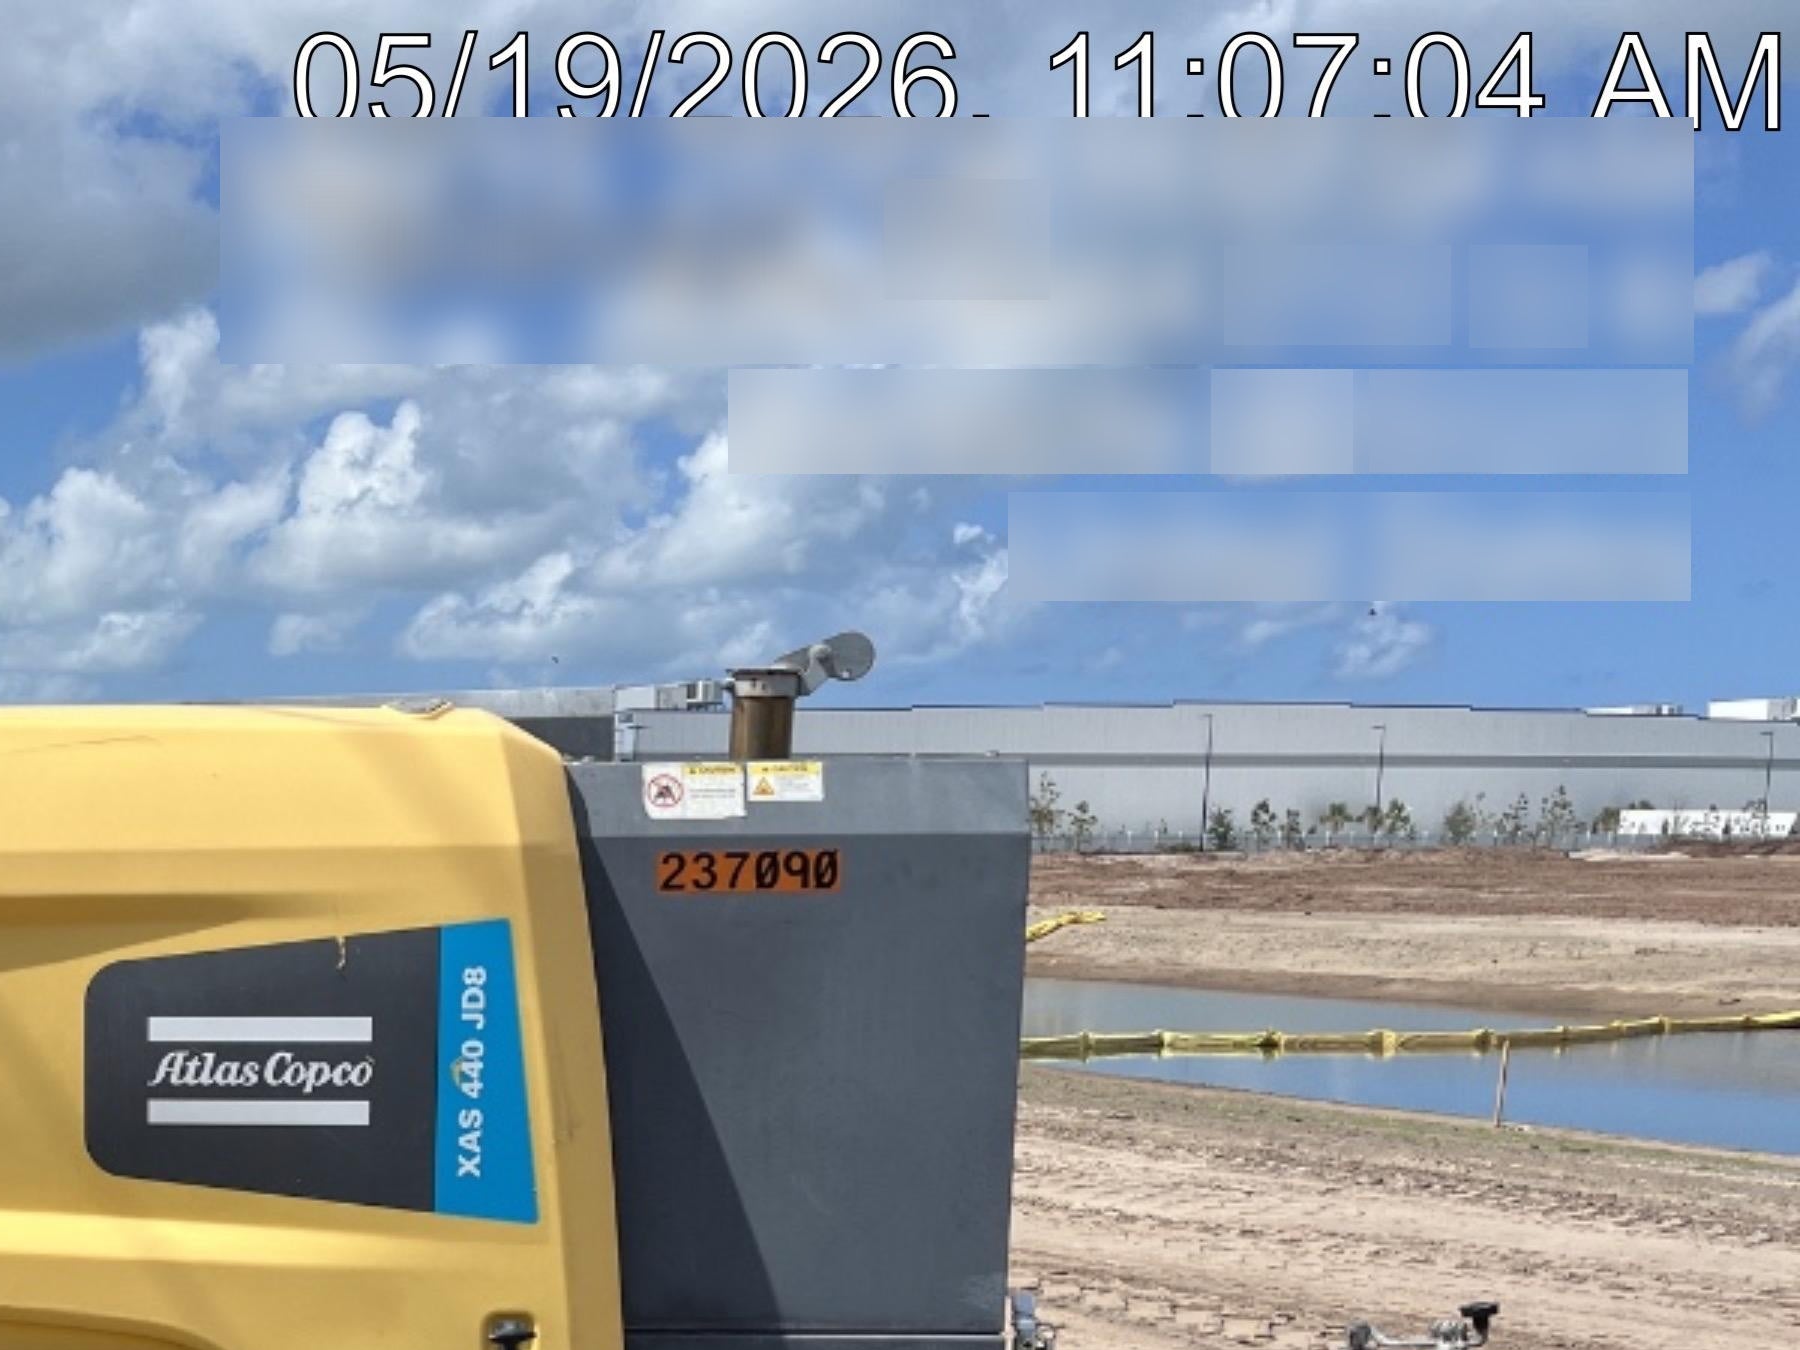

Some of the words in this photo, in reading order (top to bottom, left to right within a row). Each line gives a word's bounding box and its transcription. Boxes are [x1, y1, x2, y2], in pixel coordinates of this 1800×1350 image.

[659, 848, 839, 891] 237090
[460, 965, 488, 1030] JD8
[146, 1050, 260, 1087] Atlas
[263, 1050, 374, 1094] Copco
[459, 1039, 486, 1099] 440
[457, 1108, 484, 1178] XAS
